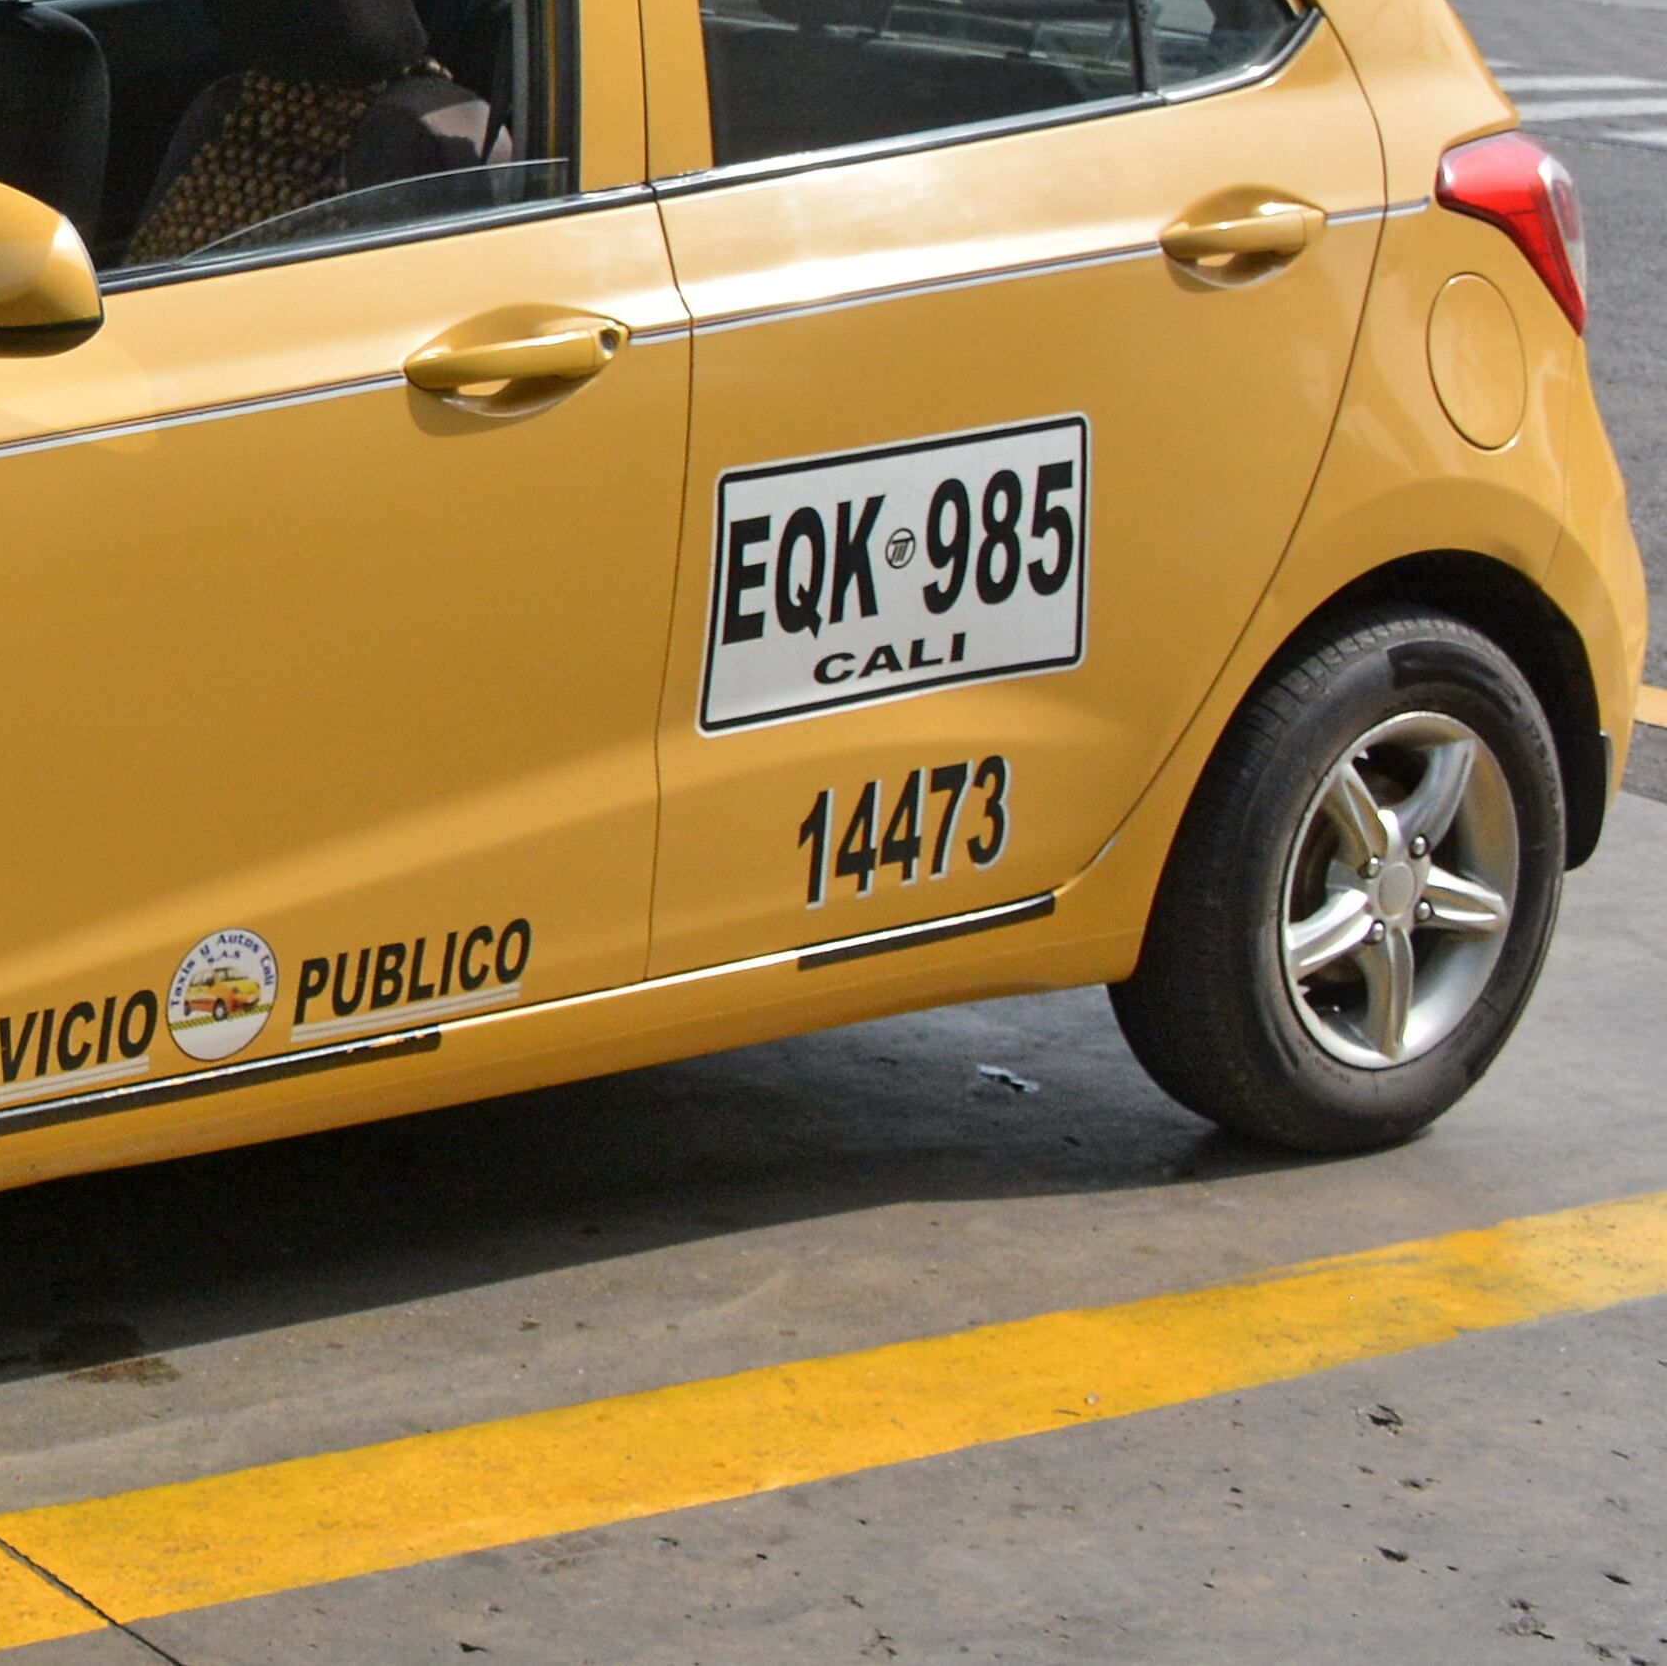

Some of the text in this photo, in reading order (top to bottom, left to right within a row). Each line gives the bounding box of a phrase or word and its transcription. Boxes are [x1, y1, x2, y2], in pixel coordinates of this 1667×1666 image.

[721, 459, 1075, 647] EQK 985
[812, 631, 967, 685] CALI
[798, 754, 1009, 909] 14473
[170, 960, 196, 1007] Taxis
[217, 933, 261, 953] Autos
[260, 955, 276, 986] Cali
[292, 917, 534, 1026] PUBLICO
